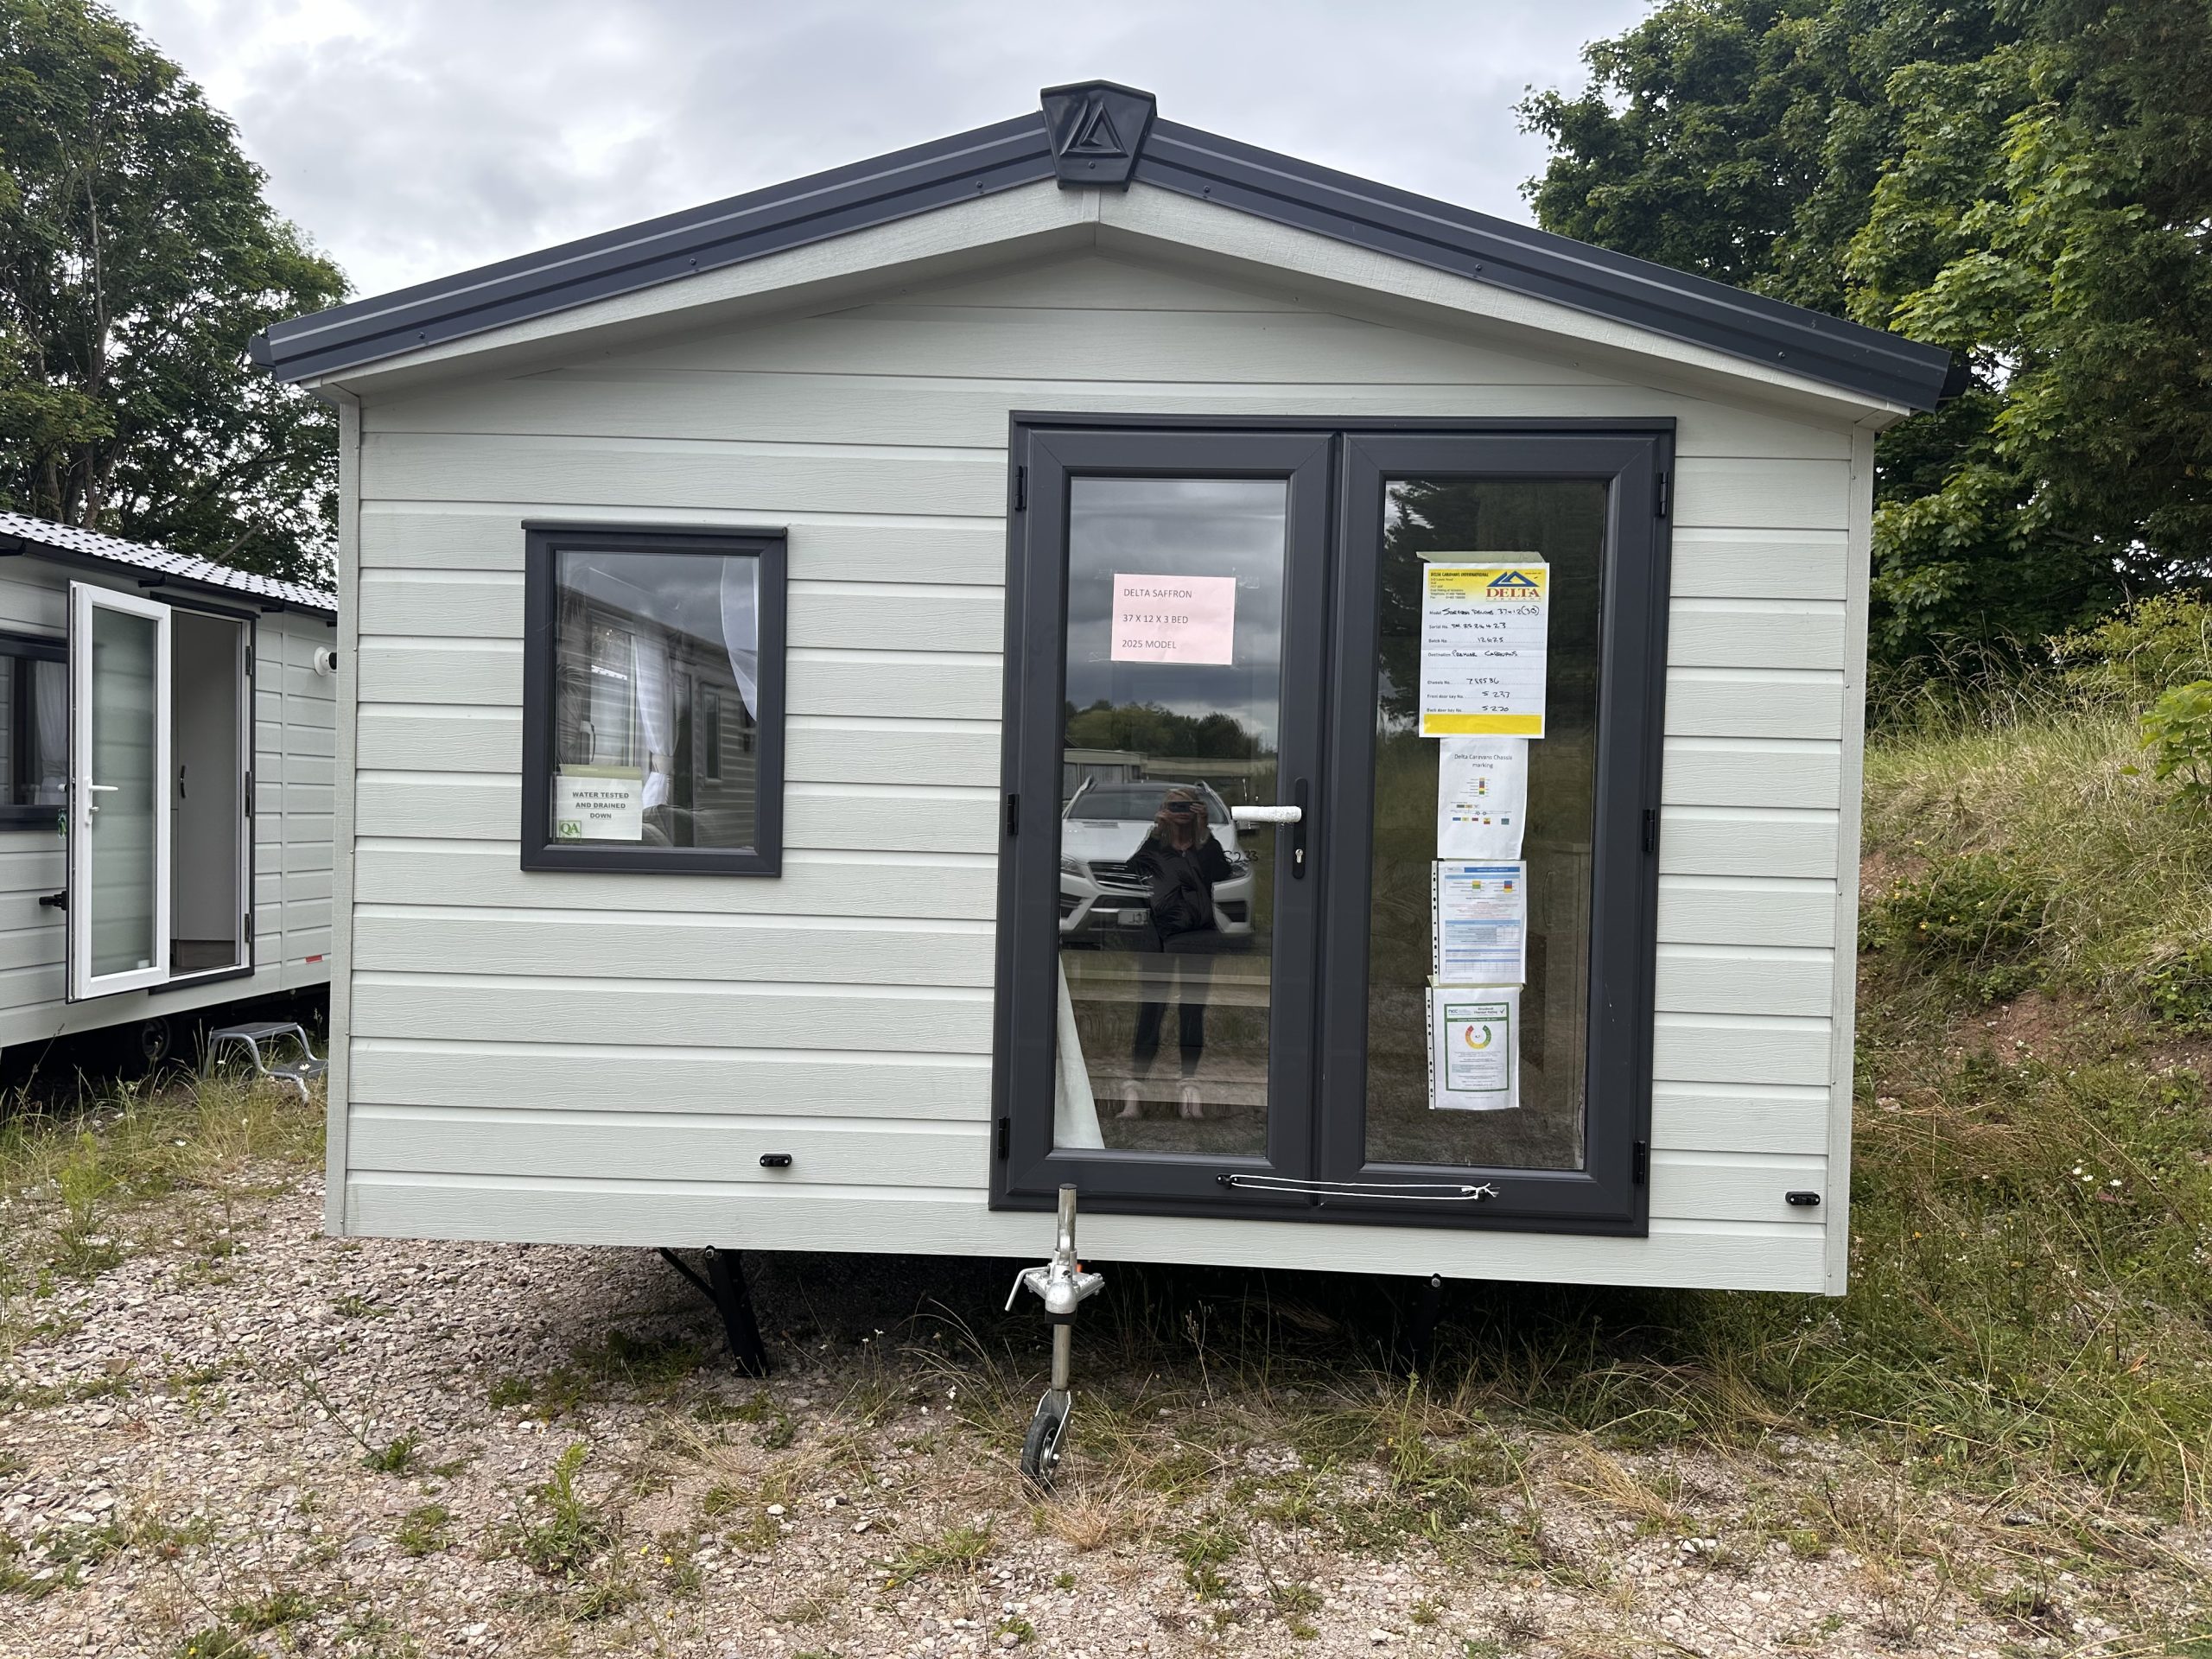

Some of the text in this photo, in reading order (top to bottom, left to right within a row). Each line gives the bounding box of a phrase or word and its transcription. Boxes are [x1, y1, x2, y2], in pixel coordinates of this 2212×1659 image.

[1123, 588, 1192, 598] DELTA SAFFRON
[1486, 588, 1541, 597] DELTA
[1122, 639, 1177, 649] 2025 MODEL
[560, 823, 581, 836] QA
